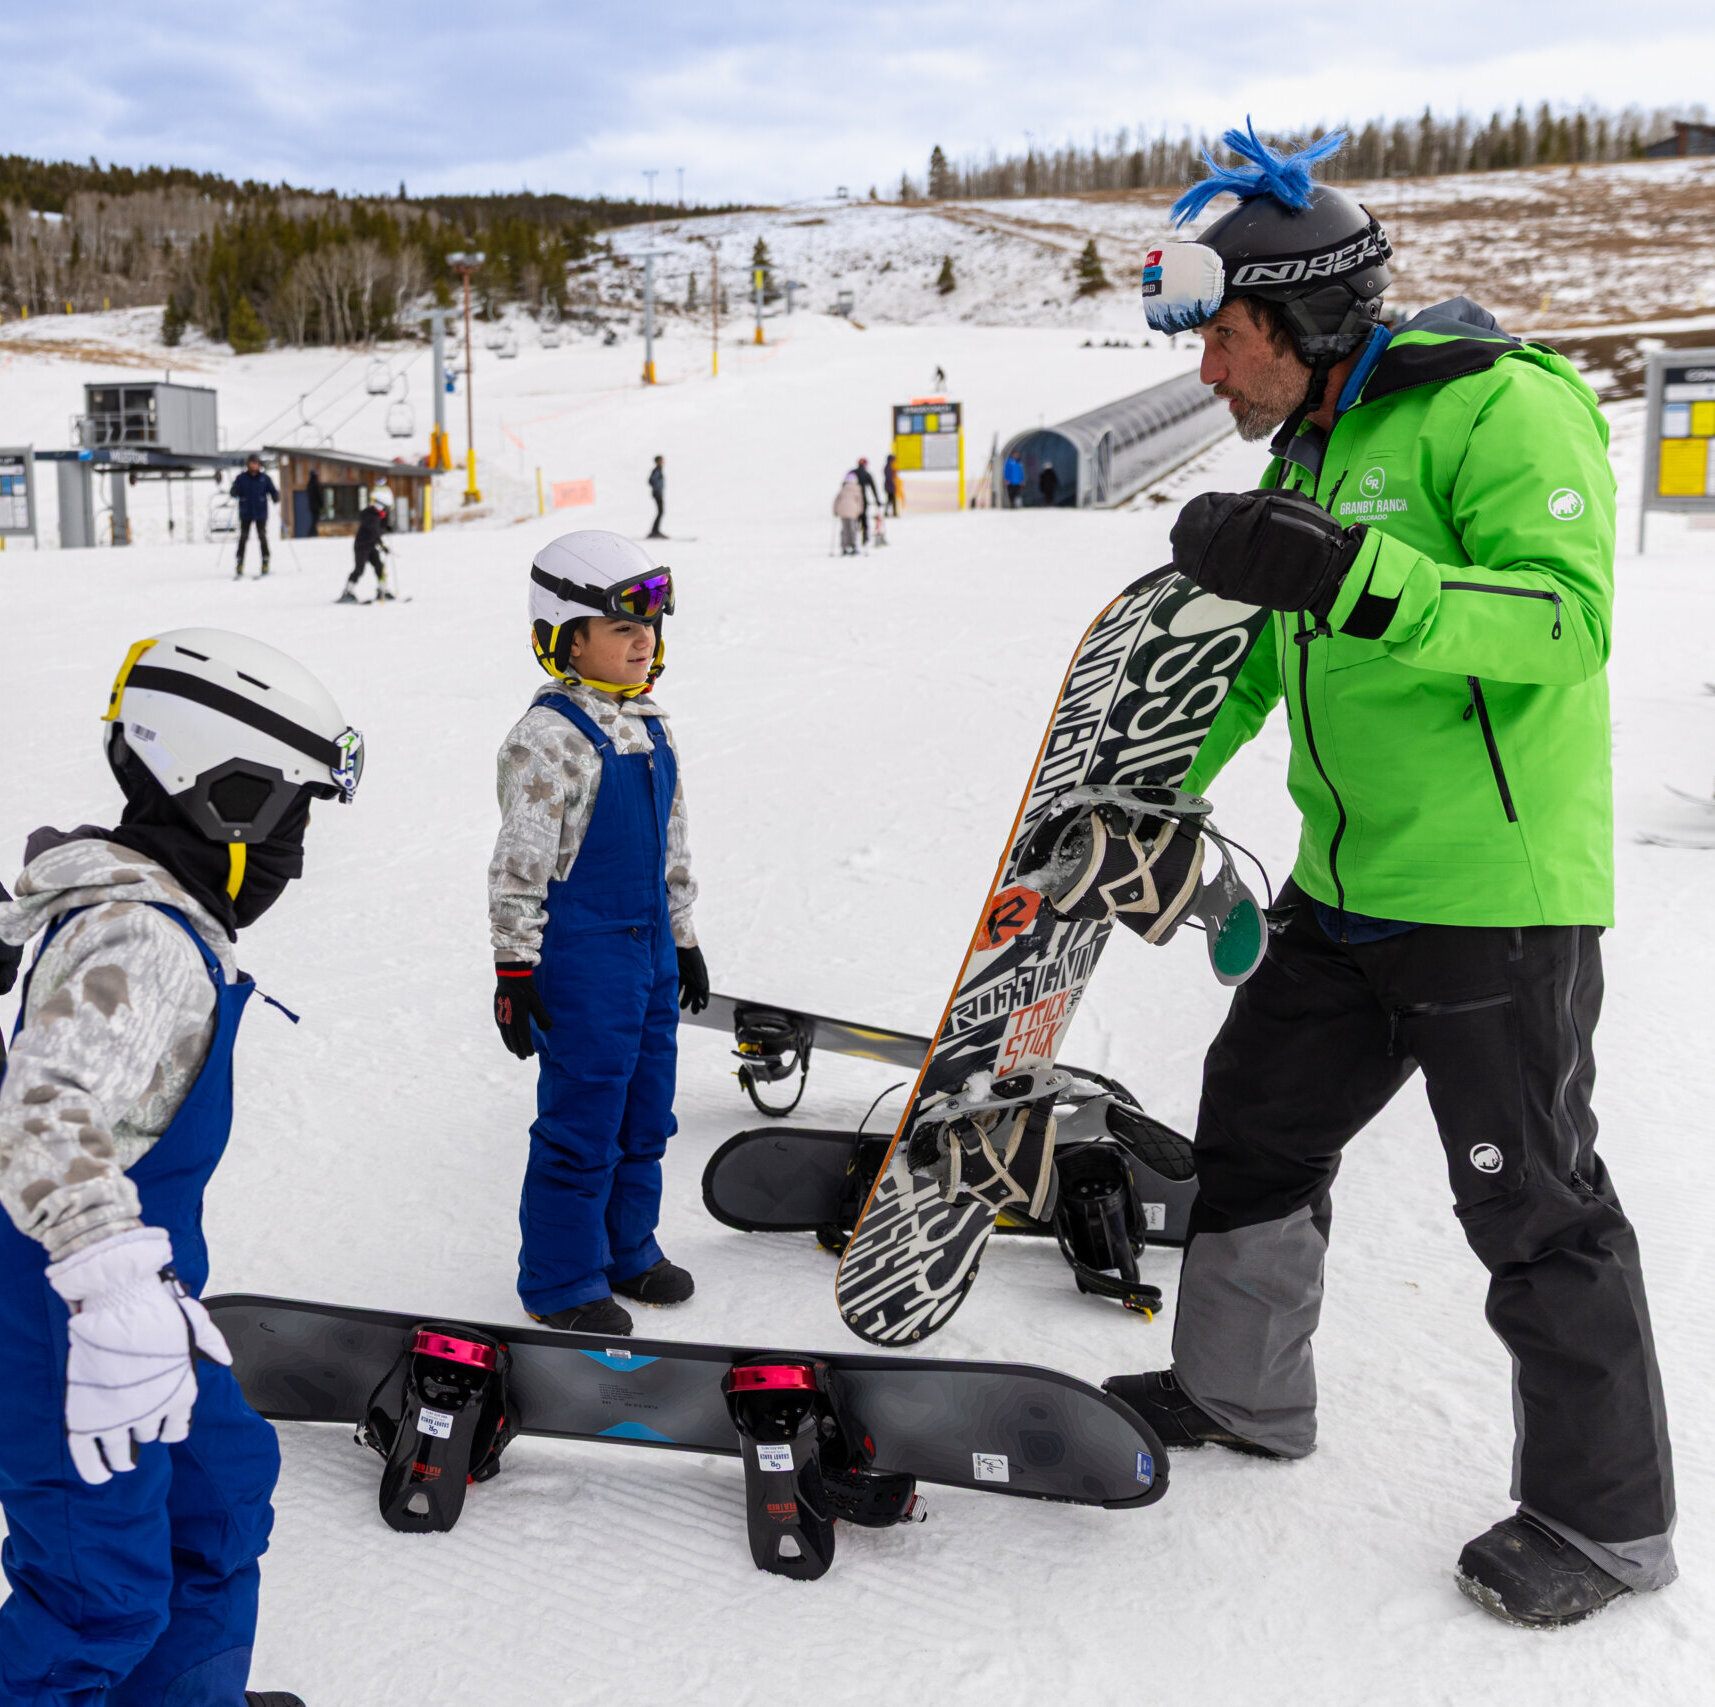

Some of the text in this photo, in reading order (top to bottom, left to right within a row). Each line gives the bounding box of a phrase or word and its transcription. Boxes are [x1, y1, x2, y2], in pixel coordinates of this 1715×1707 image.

[1340, 498, 1408, 515] GRANBY RANCH
[1355, 513, 1388, 522] COLORADO
[951, 939, 1098, 1035] ROSSIGNOL
[1010, 988, 1073, 1035] TRICK
[997, 1021, 1063, 1079] STICK
